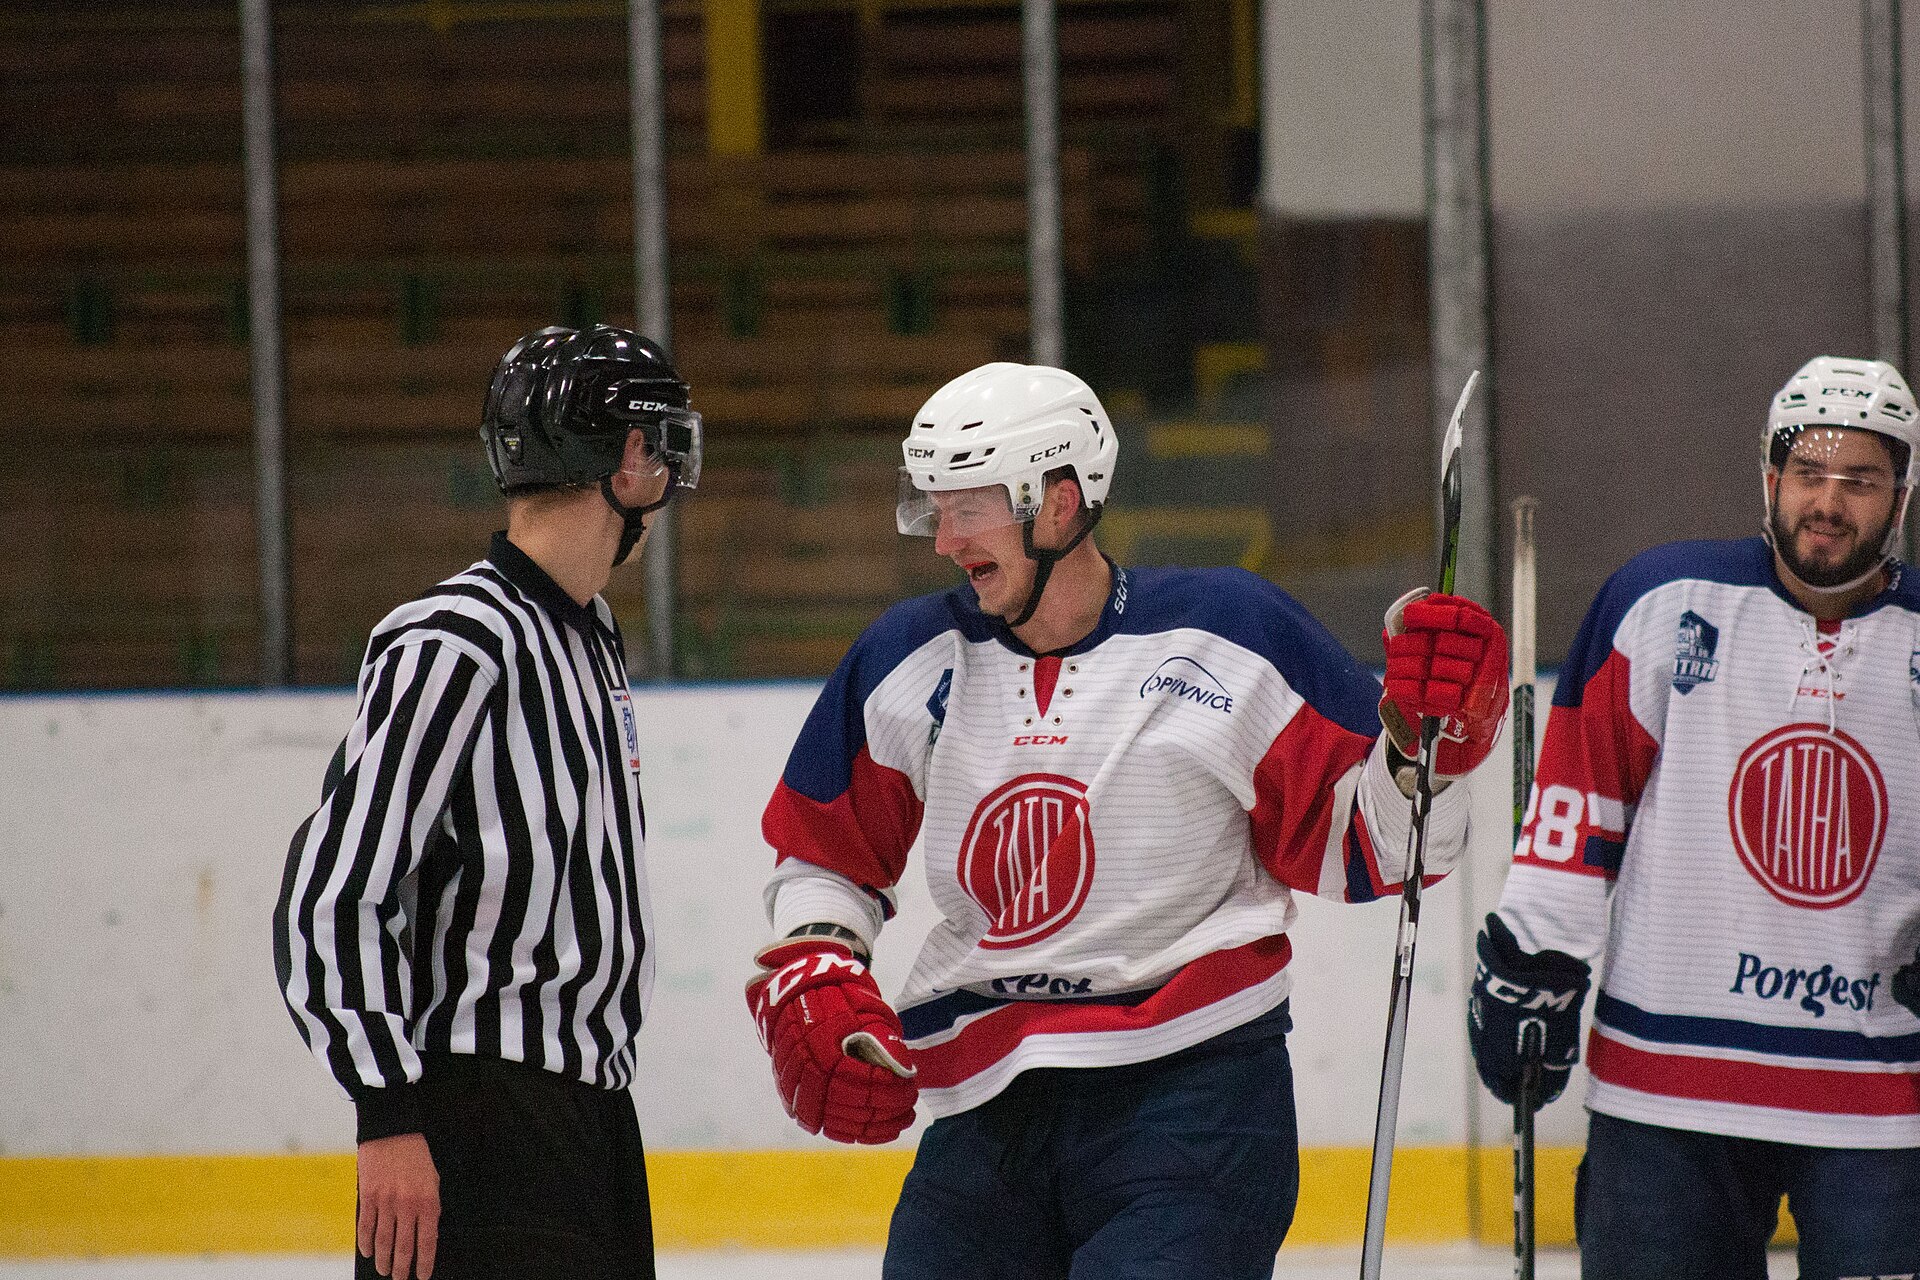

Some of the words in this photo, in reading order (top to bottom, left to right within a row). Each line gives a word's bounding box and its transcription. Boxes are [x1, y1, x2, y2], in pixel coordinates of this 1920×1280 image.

[1821, 388, 1873, 399] CCM
[629, 401, 668, 412] CCM
[908, 448, 936, 459] CCM
[1029, 441, 1071, 463] CCM
[1013, 735, 1069, 746] CCM
[1513, 781, 1586, 863] 28
[1761, 744, 1851, 890] TATRA
[1729, 952, 1881, 1019] Porgest
